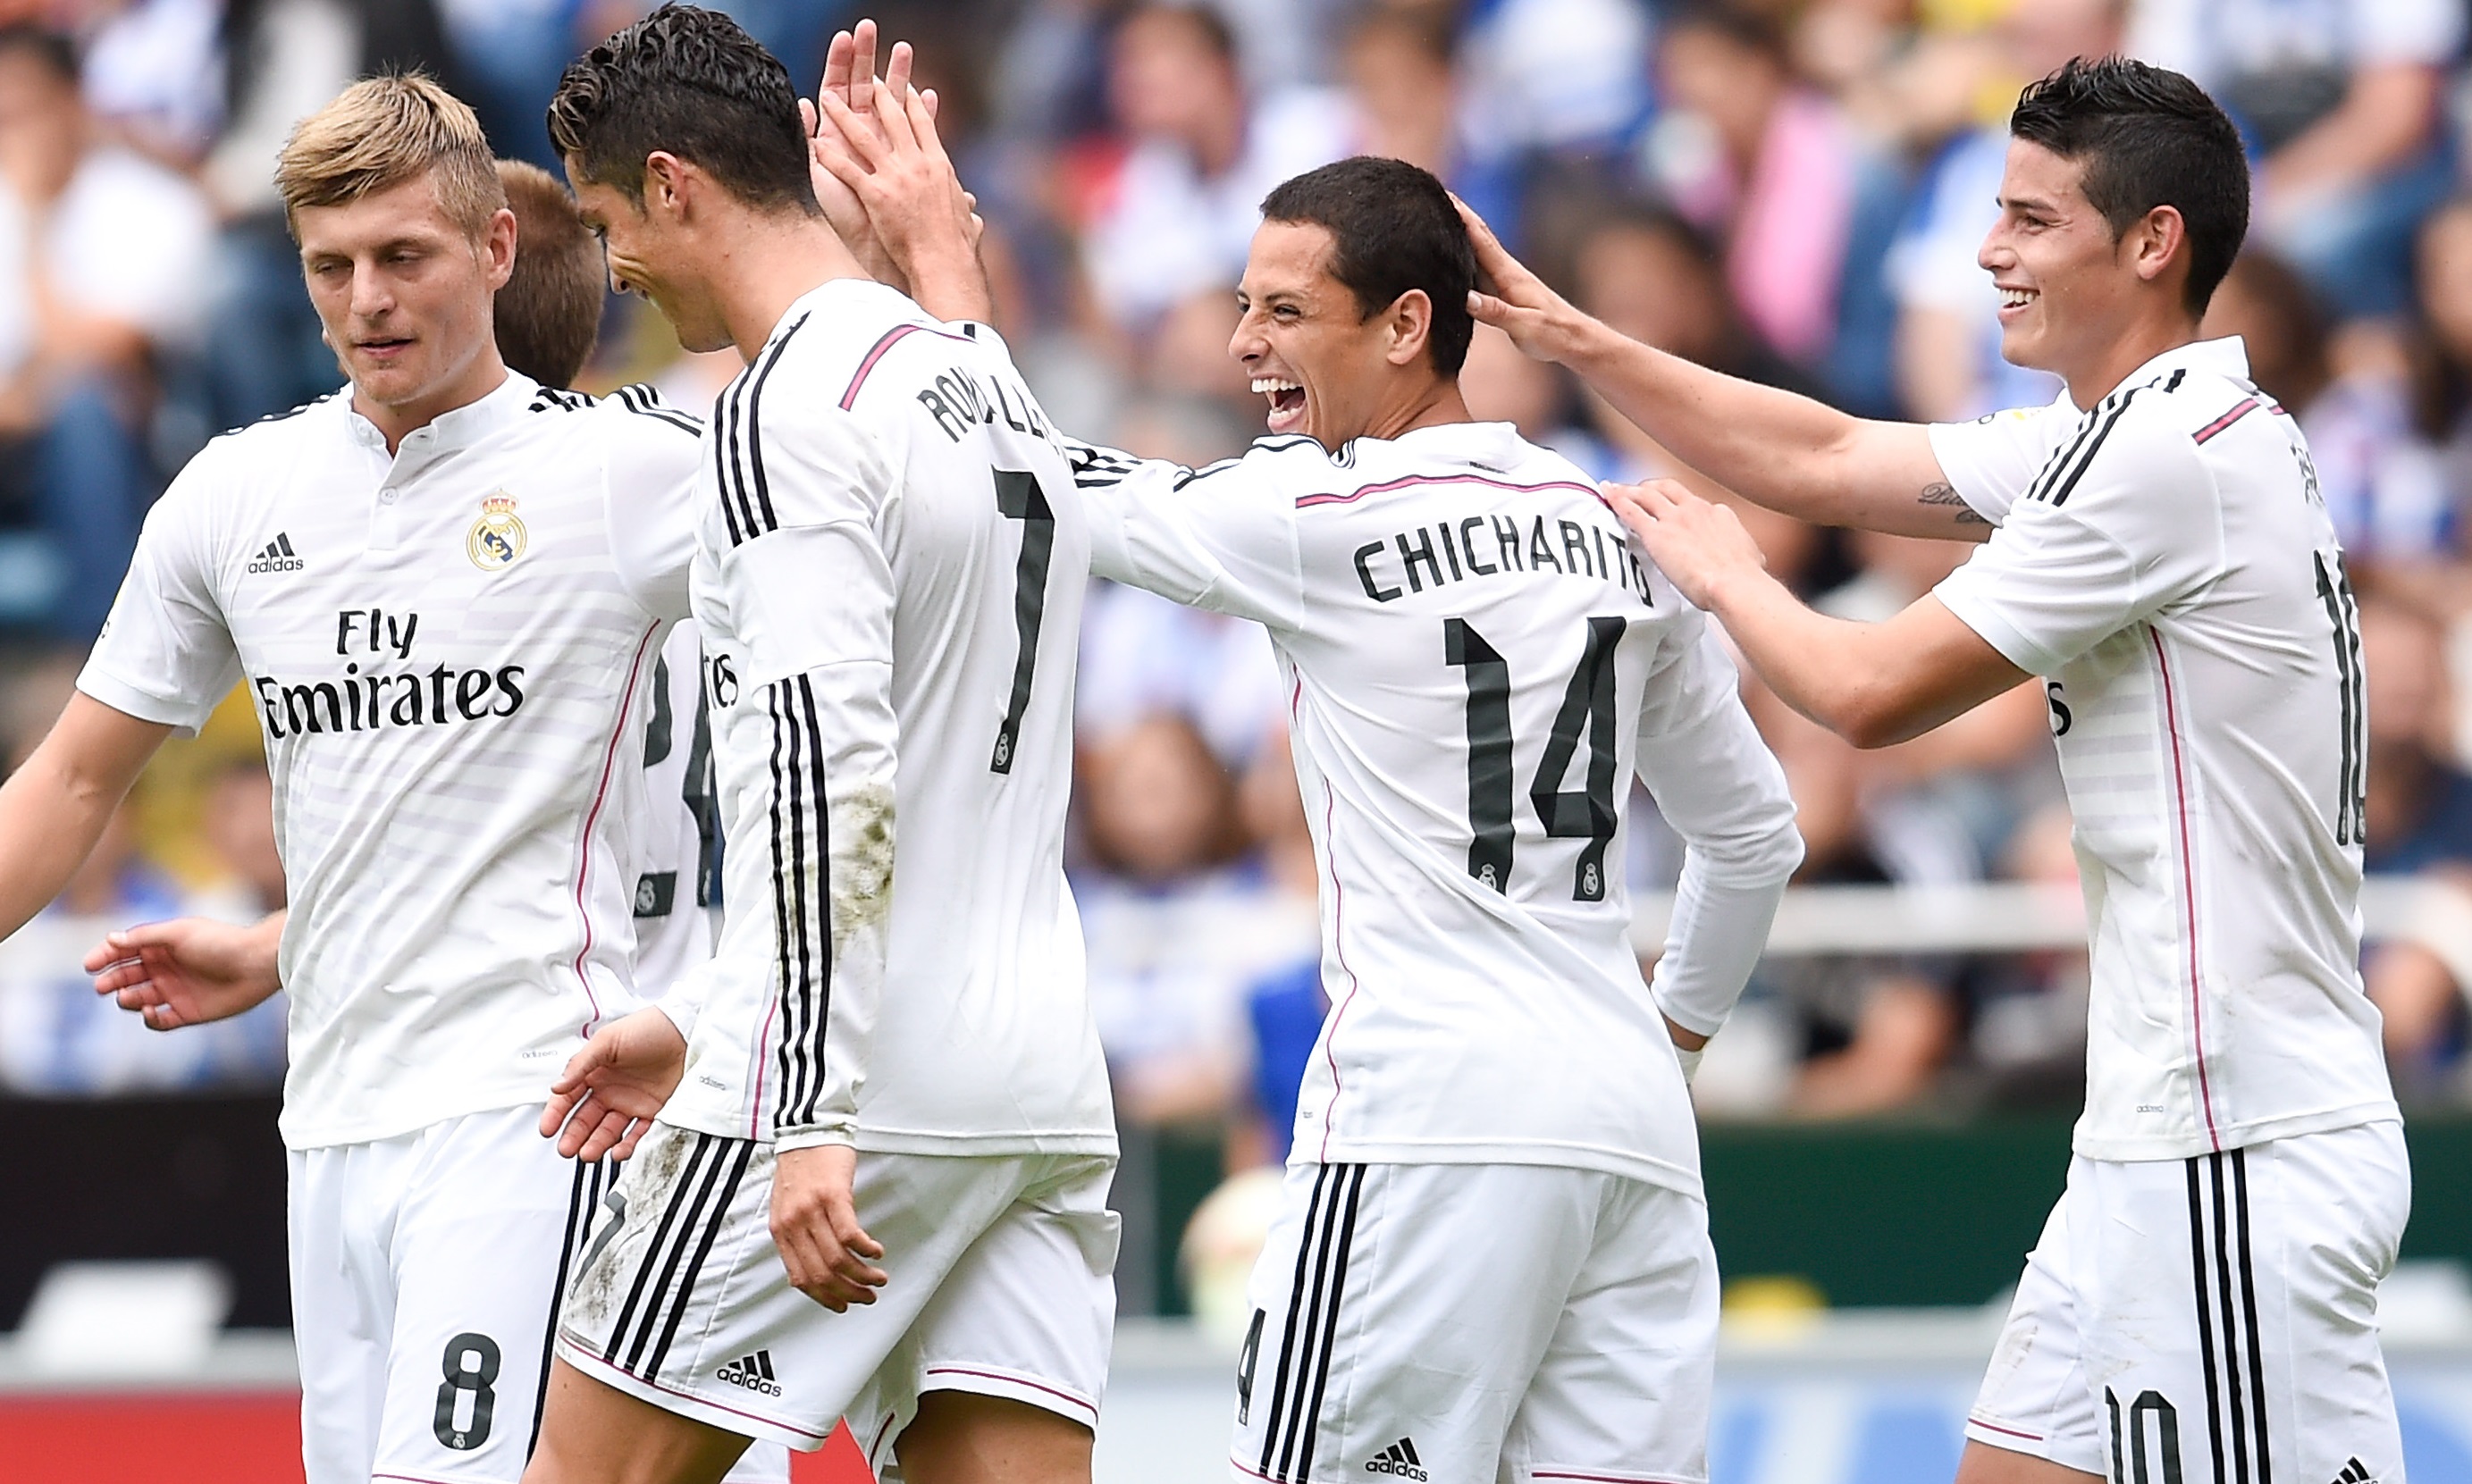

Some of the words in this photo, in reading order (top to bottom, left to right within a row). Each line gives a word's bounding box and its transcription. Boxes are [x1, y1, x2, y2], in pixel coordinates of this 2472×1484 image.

[248, 556, 304, 574] adidas
[1354, 515, 1654, 608] CHICHARITO
[337, 608, 417, 659] Fly
[991, 464, 1055, 775] 7
[255, 662, 525, 739] Emirates
[1444, 616, 1627, 901] 14
[433, 1332, 500, 1451] 8
[717, 1369, 782, 1397] adidas
[1365, 1458, 1428, 1483] adidas
[2105, 1384, 2183, 1484] 10
